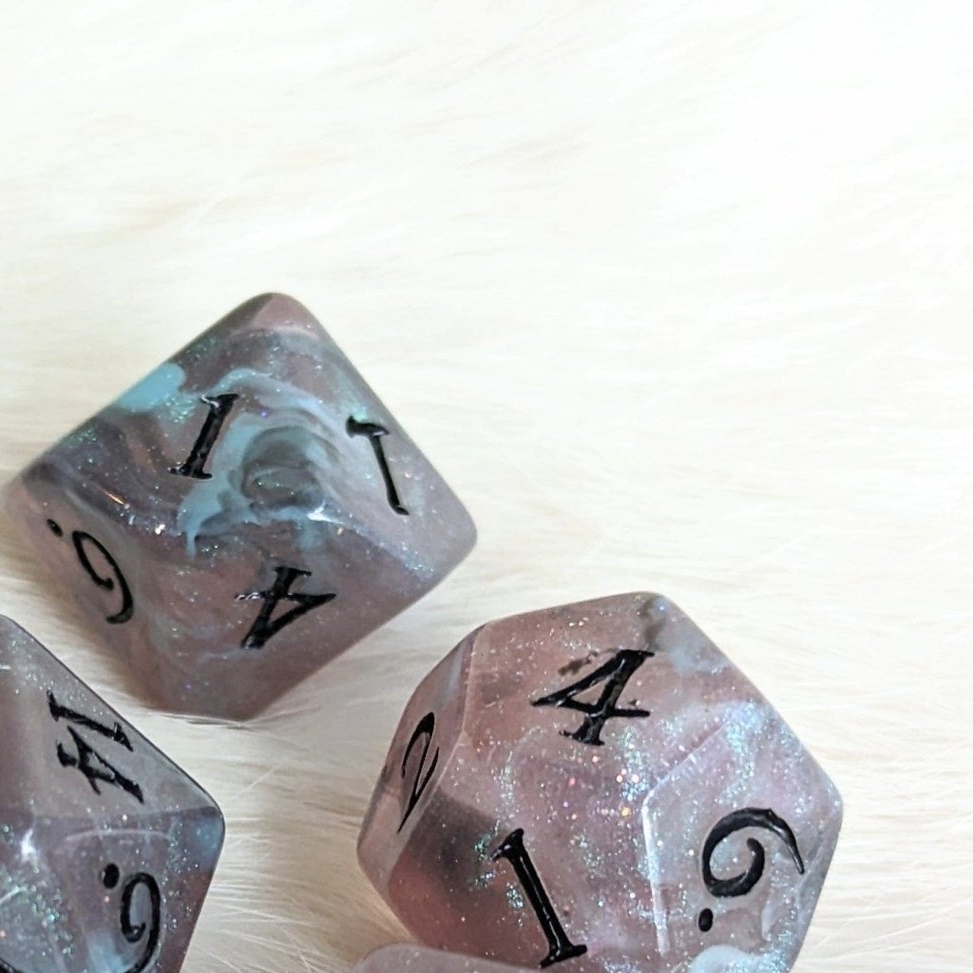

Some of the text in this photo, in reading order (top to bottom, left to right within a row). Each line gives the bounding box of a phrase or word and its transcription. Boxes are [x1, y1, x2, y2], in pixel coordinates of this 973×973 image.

[235, 566, 336, 648] 4
[46, 690, 145, 804] 14
[531, 649, 655, 745] 4
[398, 712, 439, 833] 2
[491, 828, 587, 967] 1
